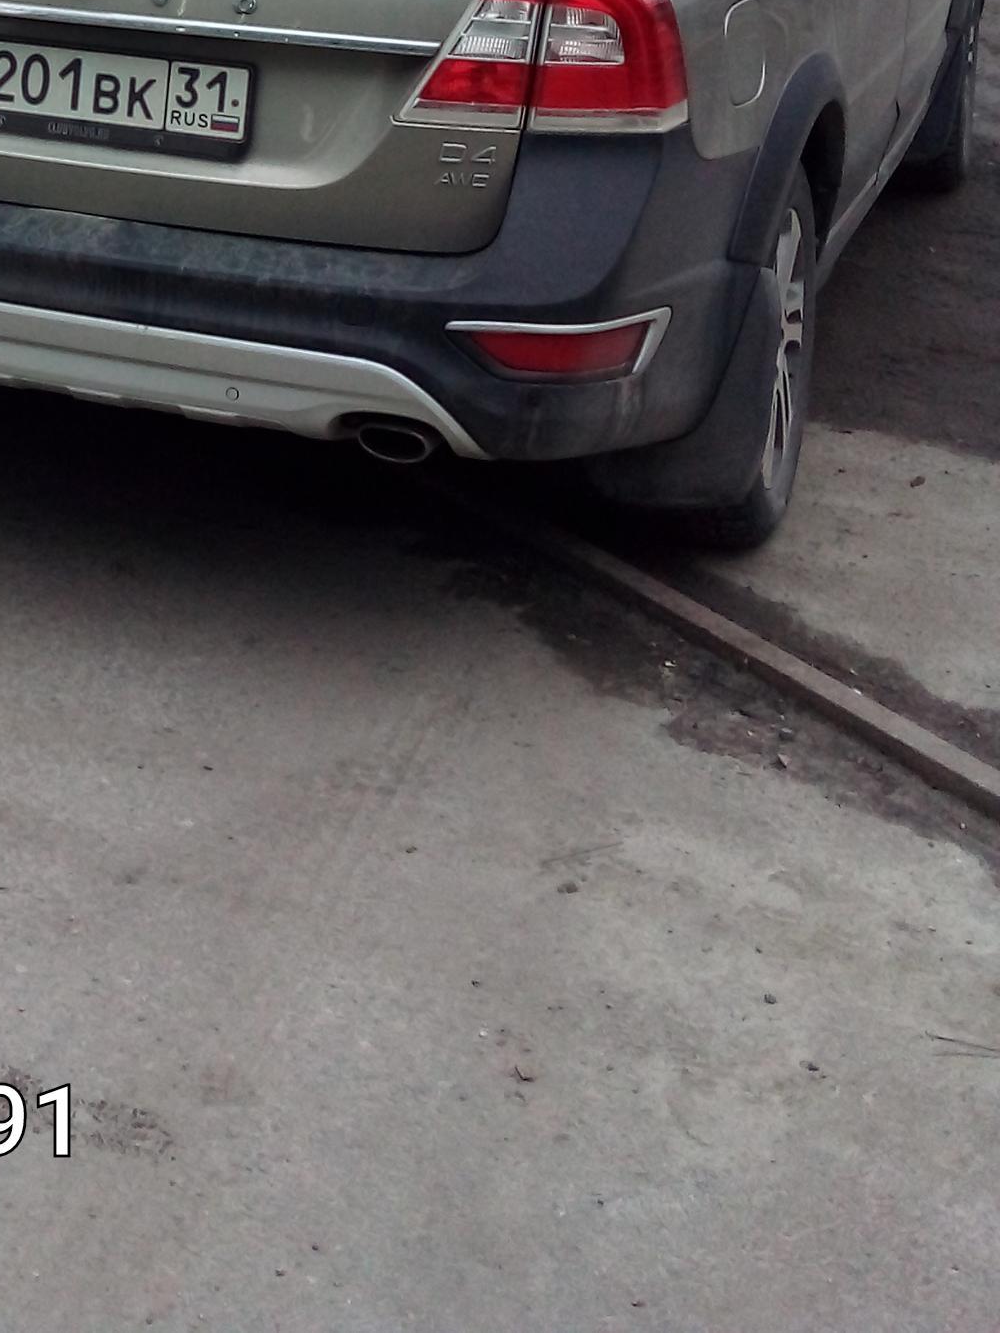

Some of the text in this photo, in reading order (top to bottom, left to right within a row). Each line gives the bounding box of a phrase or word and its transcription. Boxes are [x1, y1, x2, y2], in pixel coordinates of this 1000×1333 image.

[175, 66, 228, 113] 31
[170, 110, 209, 128] RUS
[438, 141, 498, 164] D4
